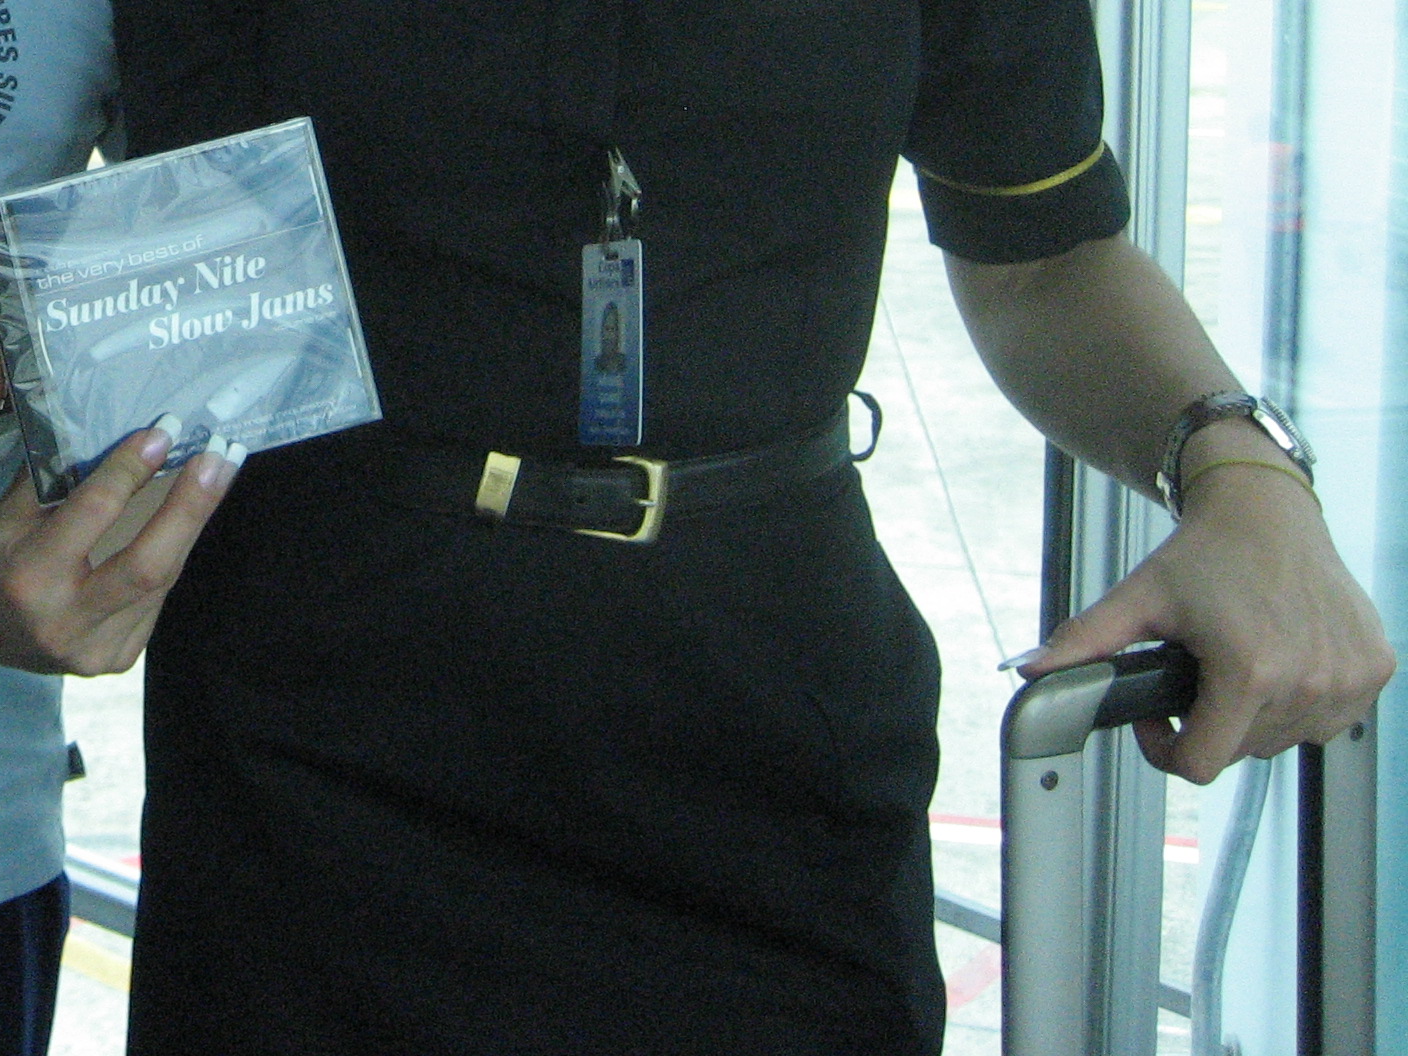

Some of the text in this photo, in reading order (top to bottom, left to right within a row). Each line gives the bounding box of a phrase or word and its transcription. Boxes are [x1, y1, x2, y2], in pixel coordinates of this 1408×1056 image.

[36, 269, 75, 291] the
[77, 257, 125, 280] very
[128, 246, 180, 267] best
[182, 234, 206, 251] of
[46, 253, 267, 333] Sunday Nite
[148, 308, 234, 351] Slow
[241, 282, 334, 331] Jams
